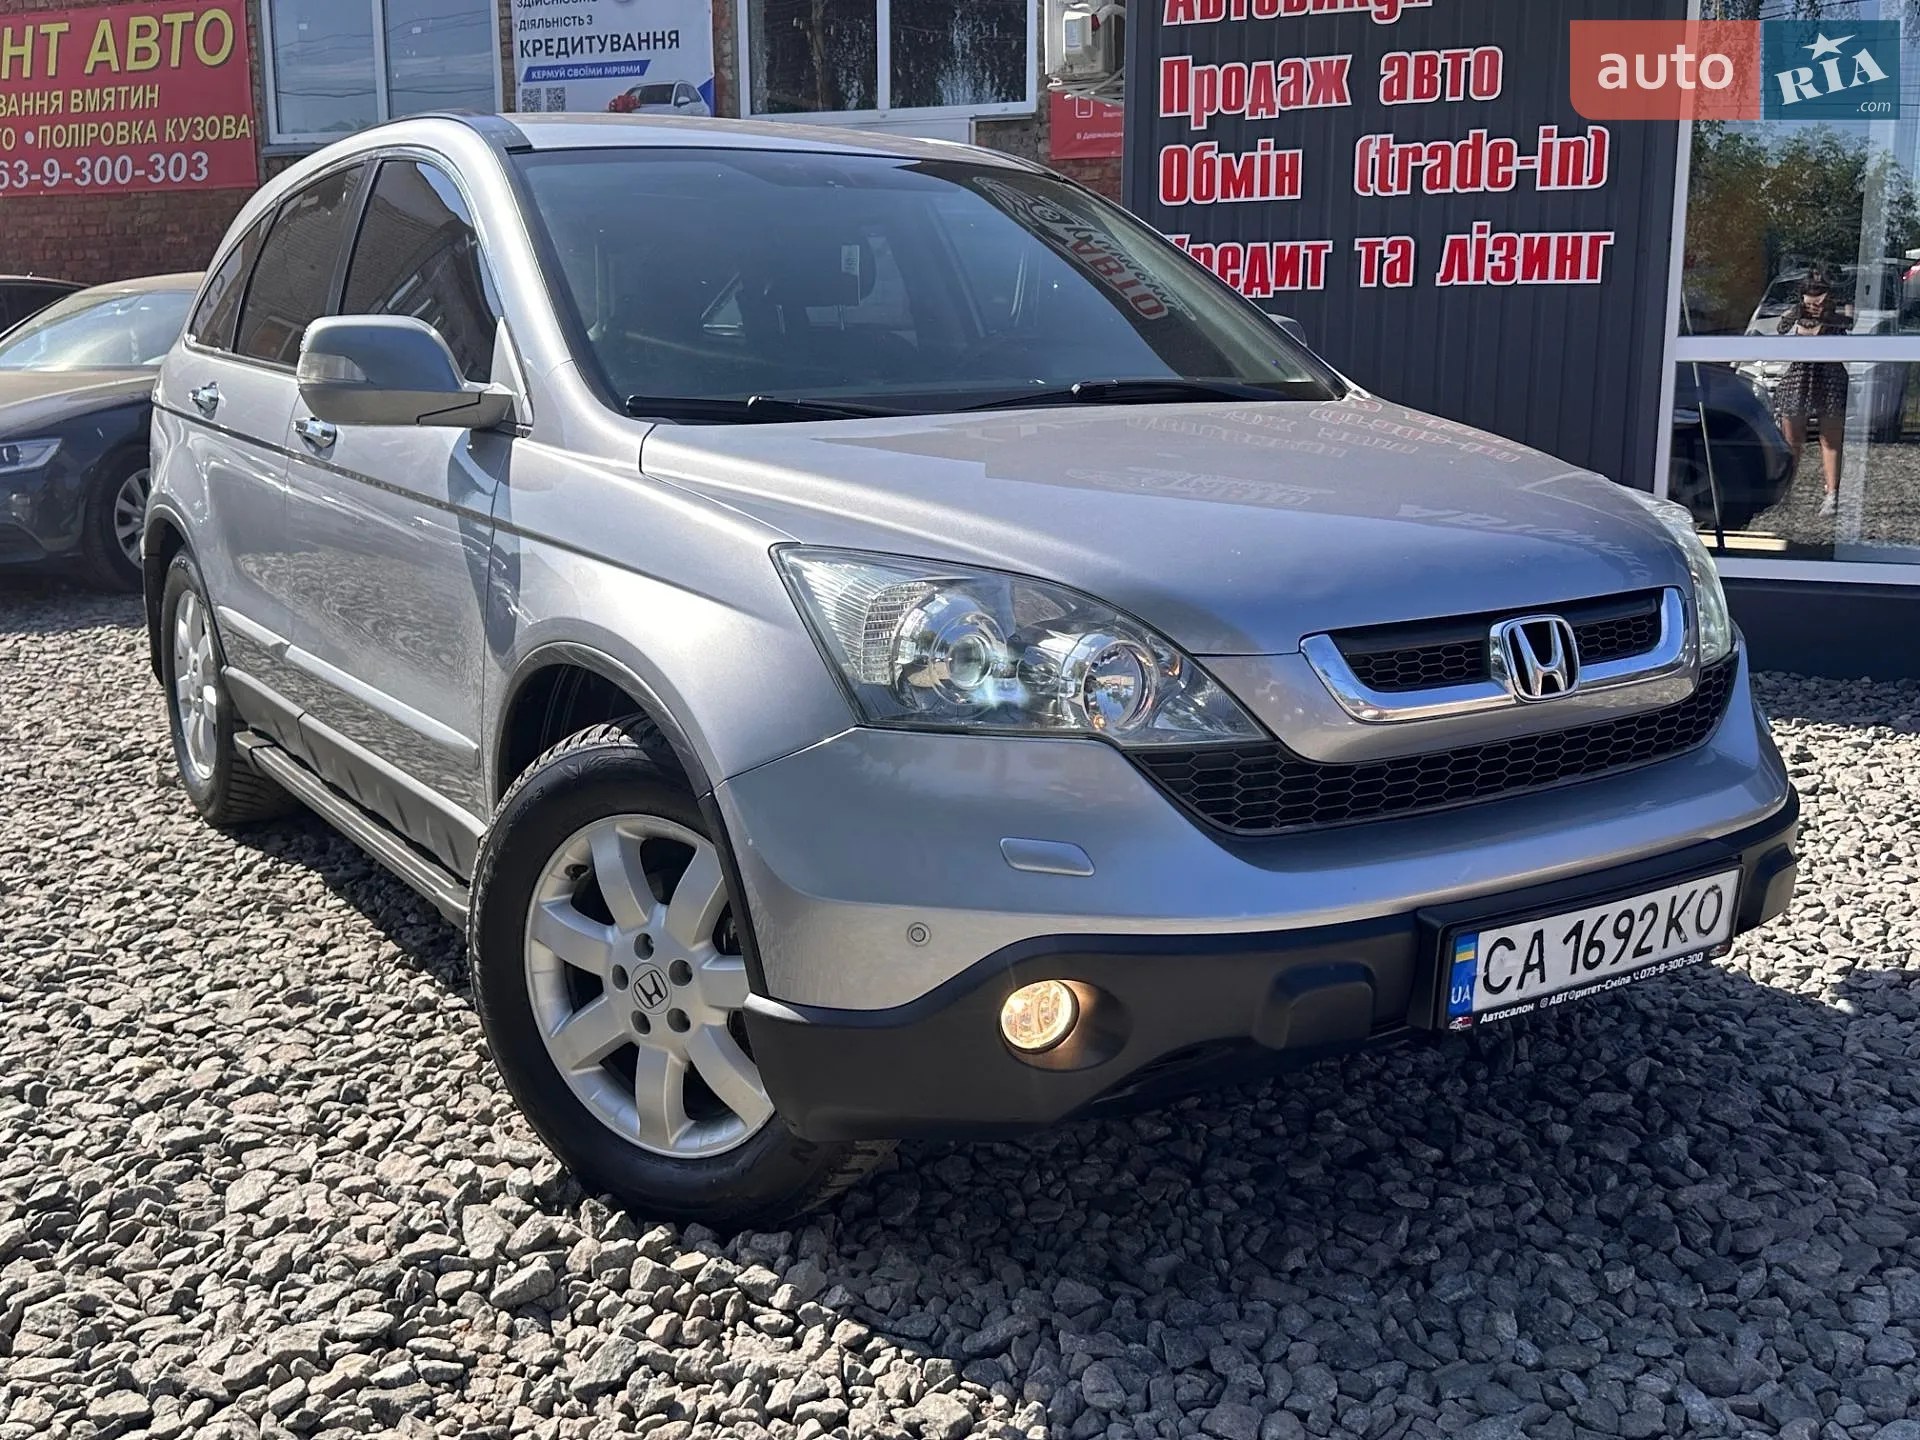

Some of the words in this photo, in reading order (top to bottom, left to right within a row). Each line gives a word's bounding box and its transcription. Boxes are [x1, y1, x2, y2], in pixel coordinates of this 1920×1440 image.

[518, 15, 585, 32] ДІЯЛЬНІСТЬ
[586, 14, 593, 26] З
[84, 8, 234, 75] АВТО
[519, 30, 680, 58] КРЕДИТУВАННЯ
[566, 65, 603, 78] СВОЇМИ
[604, 64, 640, 75] МРІЯМИ
[70, 84, 159, 114] ВМЯТИН
[1160, 55, 1353, 130] Продаж
[1379, 47, 1504, 105] авто
[38, 119, 157, 150] ПОЛІРОВКА
[165, 114, 252, 143] КУЗОВА
[1159, 139, 1303, 206] Обмін
[1354, 125, 1610, 197] (trade-in)
[1354, 235, 1416, 288] та
[1436, 221, 1615, 287] лізинг
[1482, 929, 1546, 995] CA
[1450, 984, 1471, 1004] UA
[1480, 1002, 1534, 1024] Автосалон
